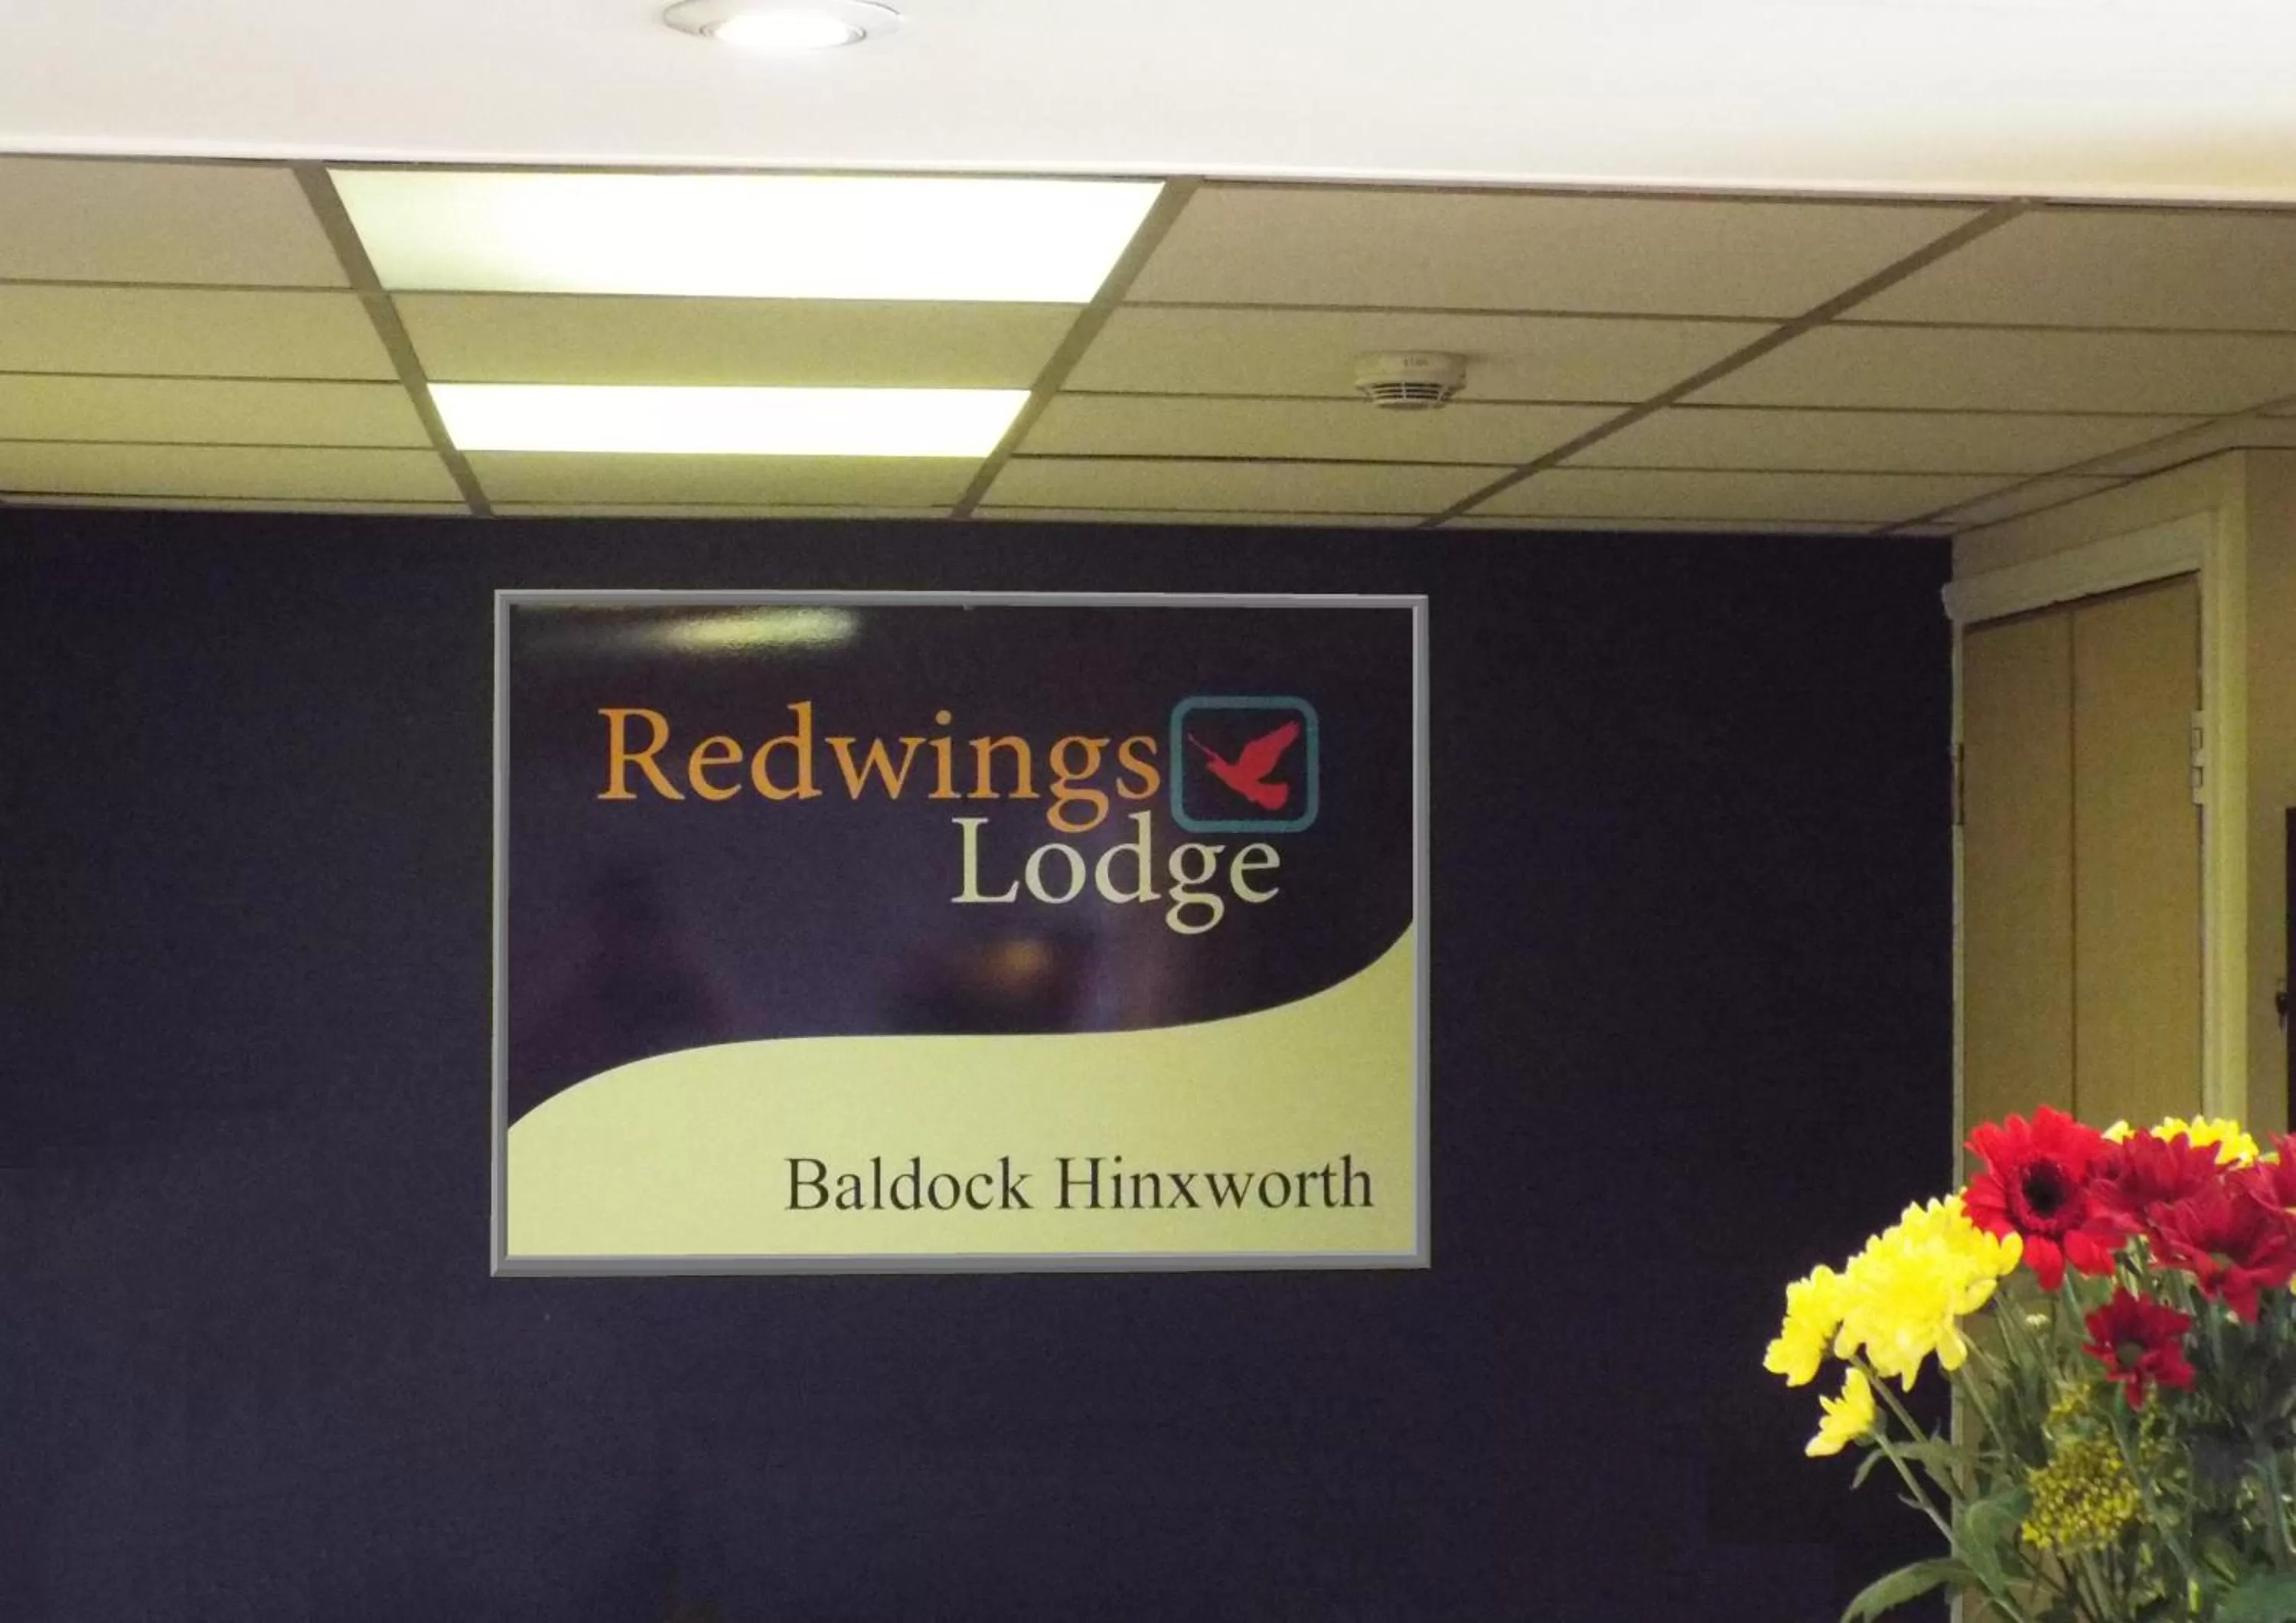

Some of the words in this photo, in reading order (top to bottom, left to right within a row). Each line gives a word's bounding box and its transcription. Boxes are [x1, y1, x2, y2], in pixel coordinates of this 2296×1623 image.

[597, 700, 1161, 832] Redwings
[951, 812, 1280, 935] Lodge
[785, 1156, 1031, 1211] Baldock
[1057, 1154, 1374, 1210] Hinxworth
